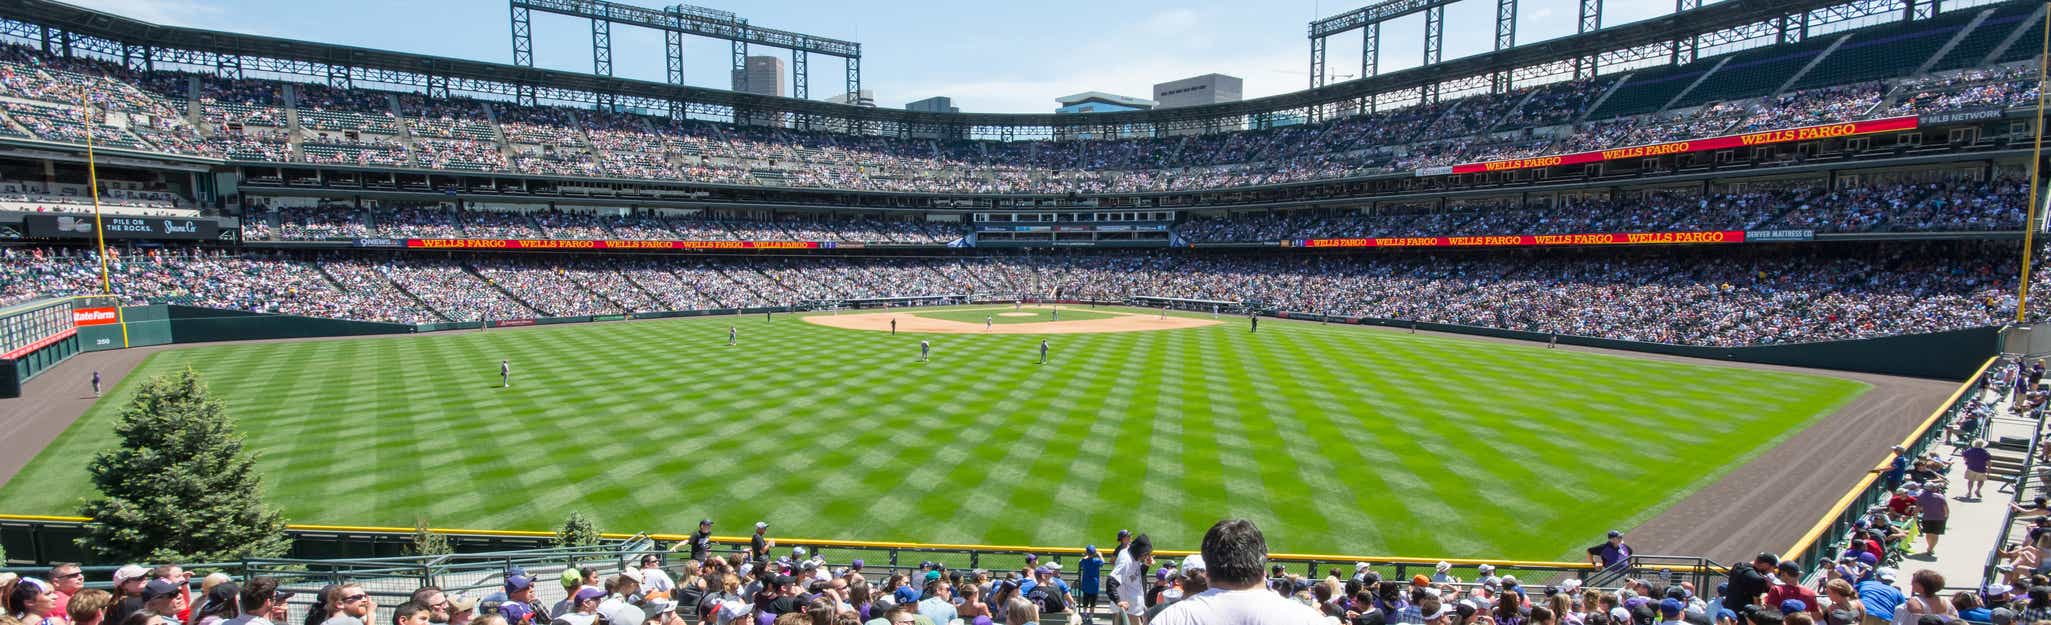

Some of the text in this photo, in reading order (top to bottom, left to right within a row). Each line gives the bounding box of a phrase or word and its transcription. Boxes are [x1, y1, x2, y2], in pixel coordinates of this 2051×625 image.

[1928, 110, 2001, 124] MLB NETWORK
[1740, 123, 1856, 146] WELLS FARGO
[1601, 142, 1689, 160] WELLS FARGO
[1485, 156, 1562, 171] WELLS FARGO
[1375, 237, 1438, 246] WELLS FARGO
[1448, 236, 1521, 246] WELLS FARGO
[1535, 234, 1613, 245] WELLS FARGO
[1627, 232, 1724, 244] WELLS FARGO
[422, 239, 506, 248] WELLS FARGO
[518, 239, 594, 248] WELLS FARGO
[605, 240, 673, 248] WELLS FARGO
[683, 240, 744, 249] WELLS FARGO
[752, 241, 808, 249] WELLS FARGO
[1313, 239, 1367, 247] WELLS FARGO
